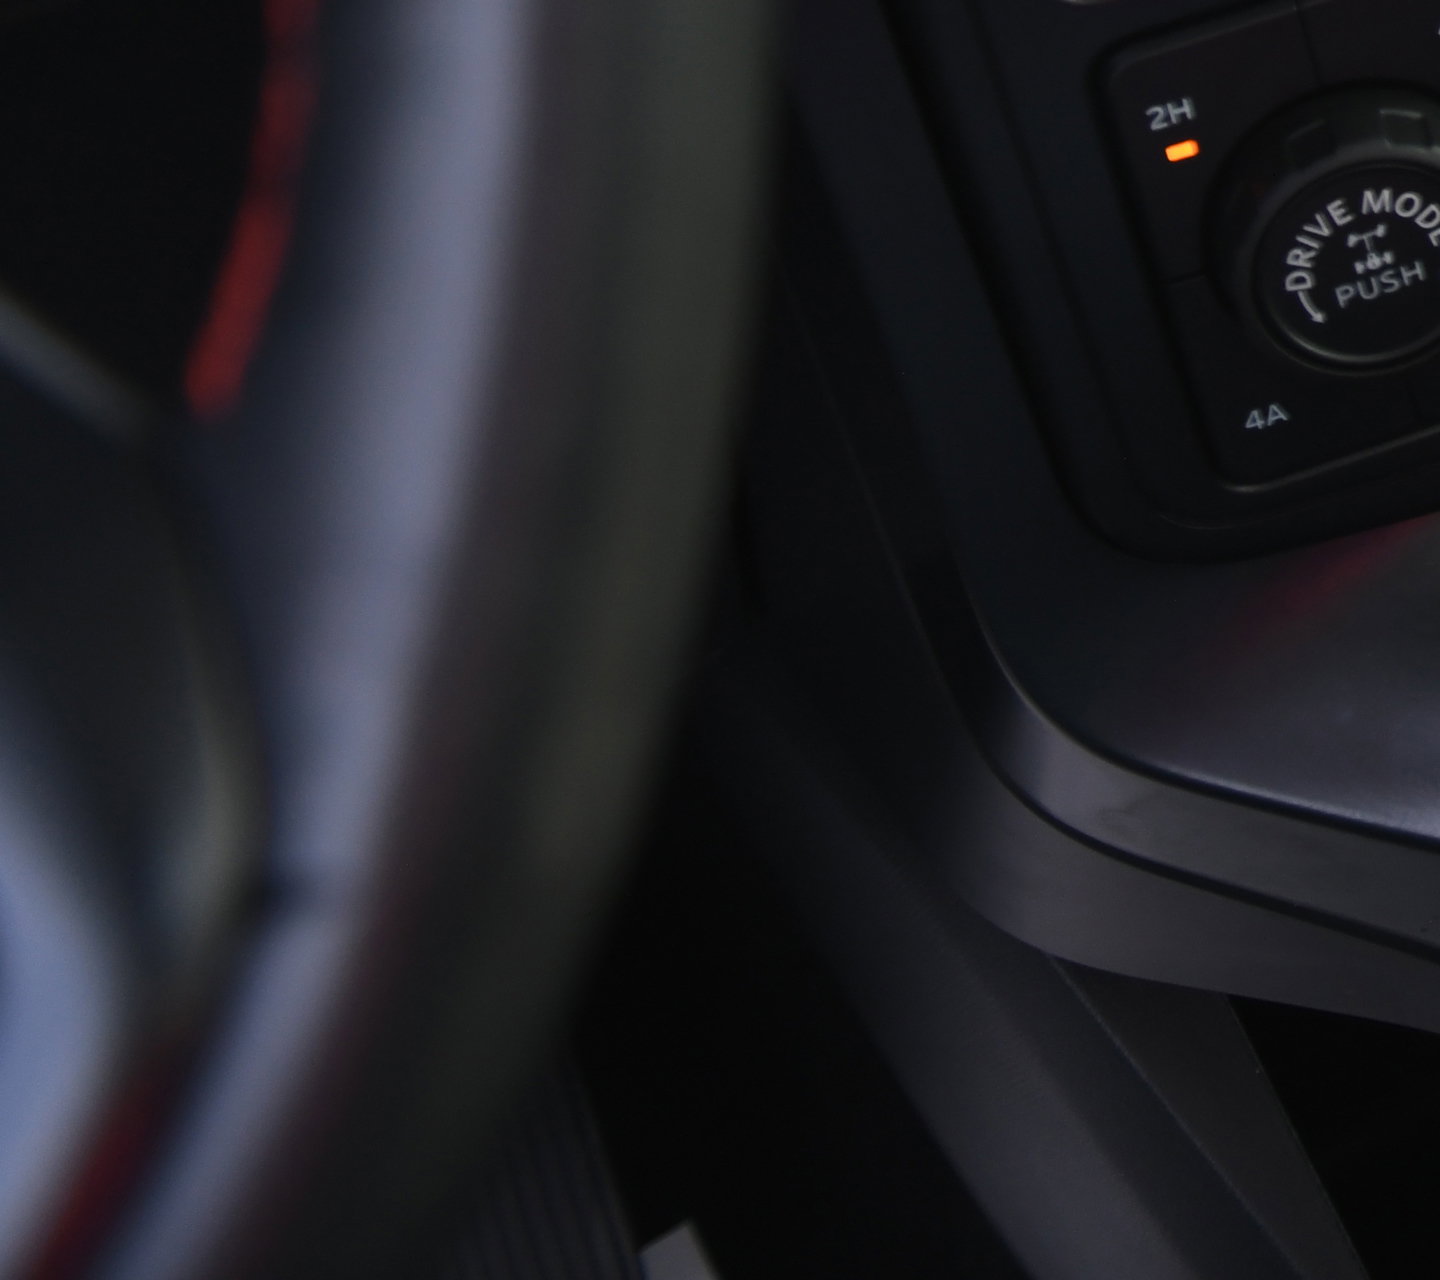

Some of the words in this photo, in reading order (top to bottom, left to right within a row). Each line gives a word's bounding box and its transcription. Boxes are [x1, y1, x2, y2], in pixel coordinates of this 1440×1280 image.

[1145, 99, 1193, 131] 2H
[1285, 197, 1353, 293] DRIVE
[1335, 260, 1428, 309] PUSH
[1244, 403, 1291, 432] 4A
